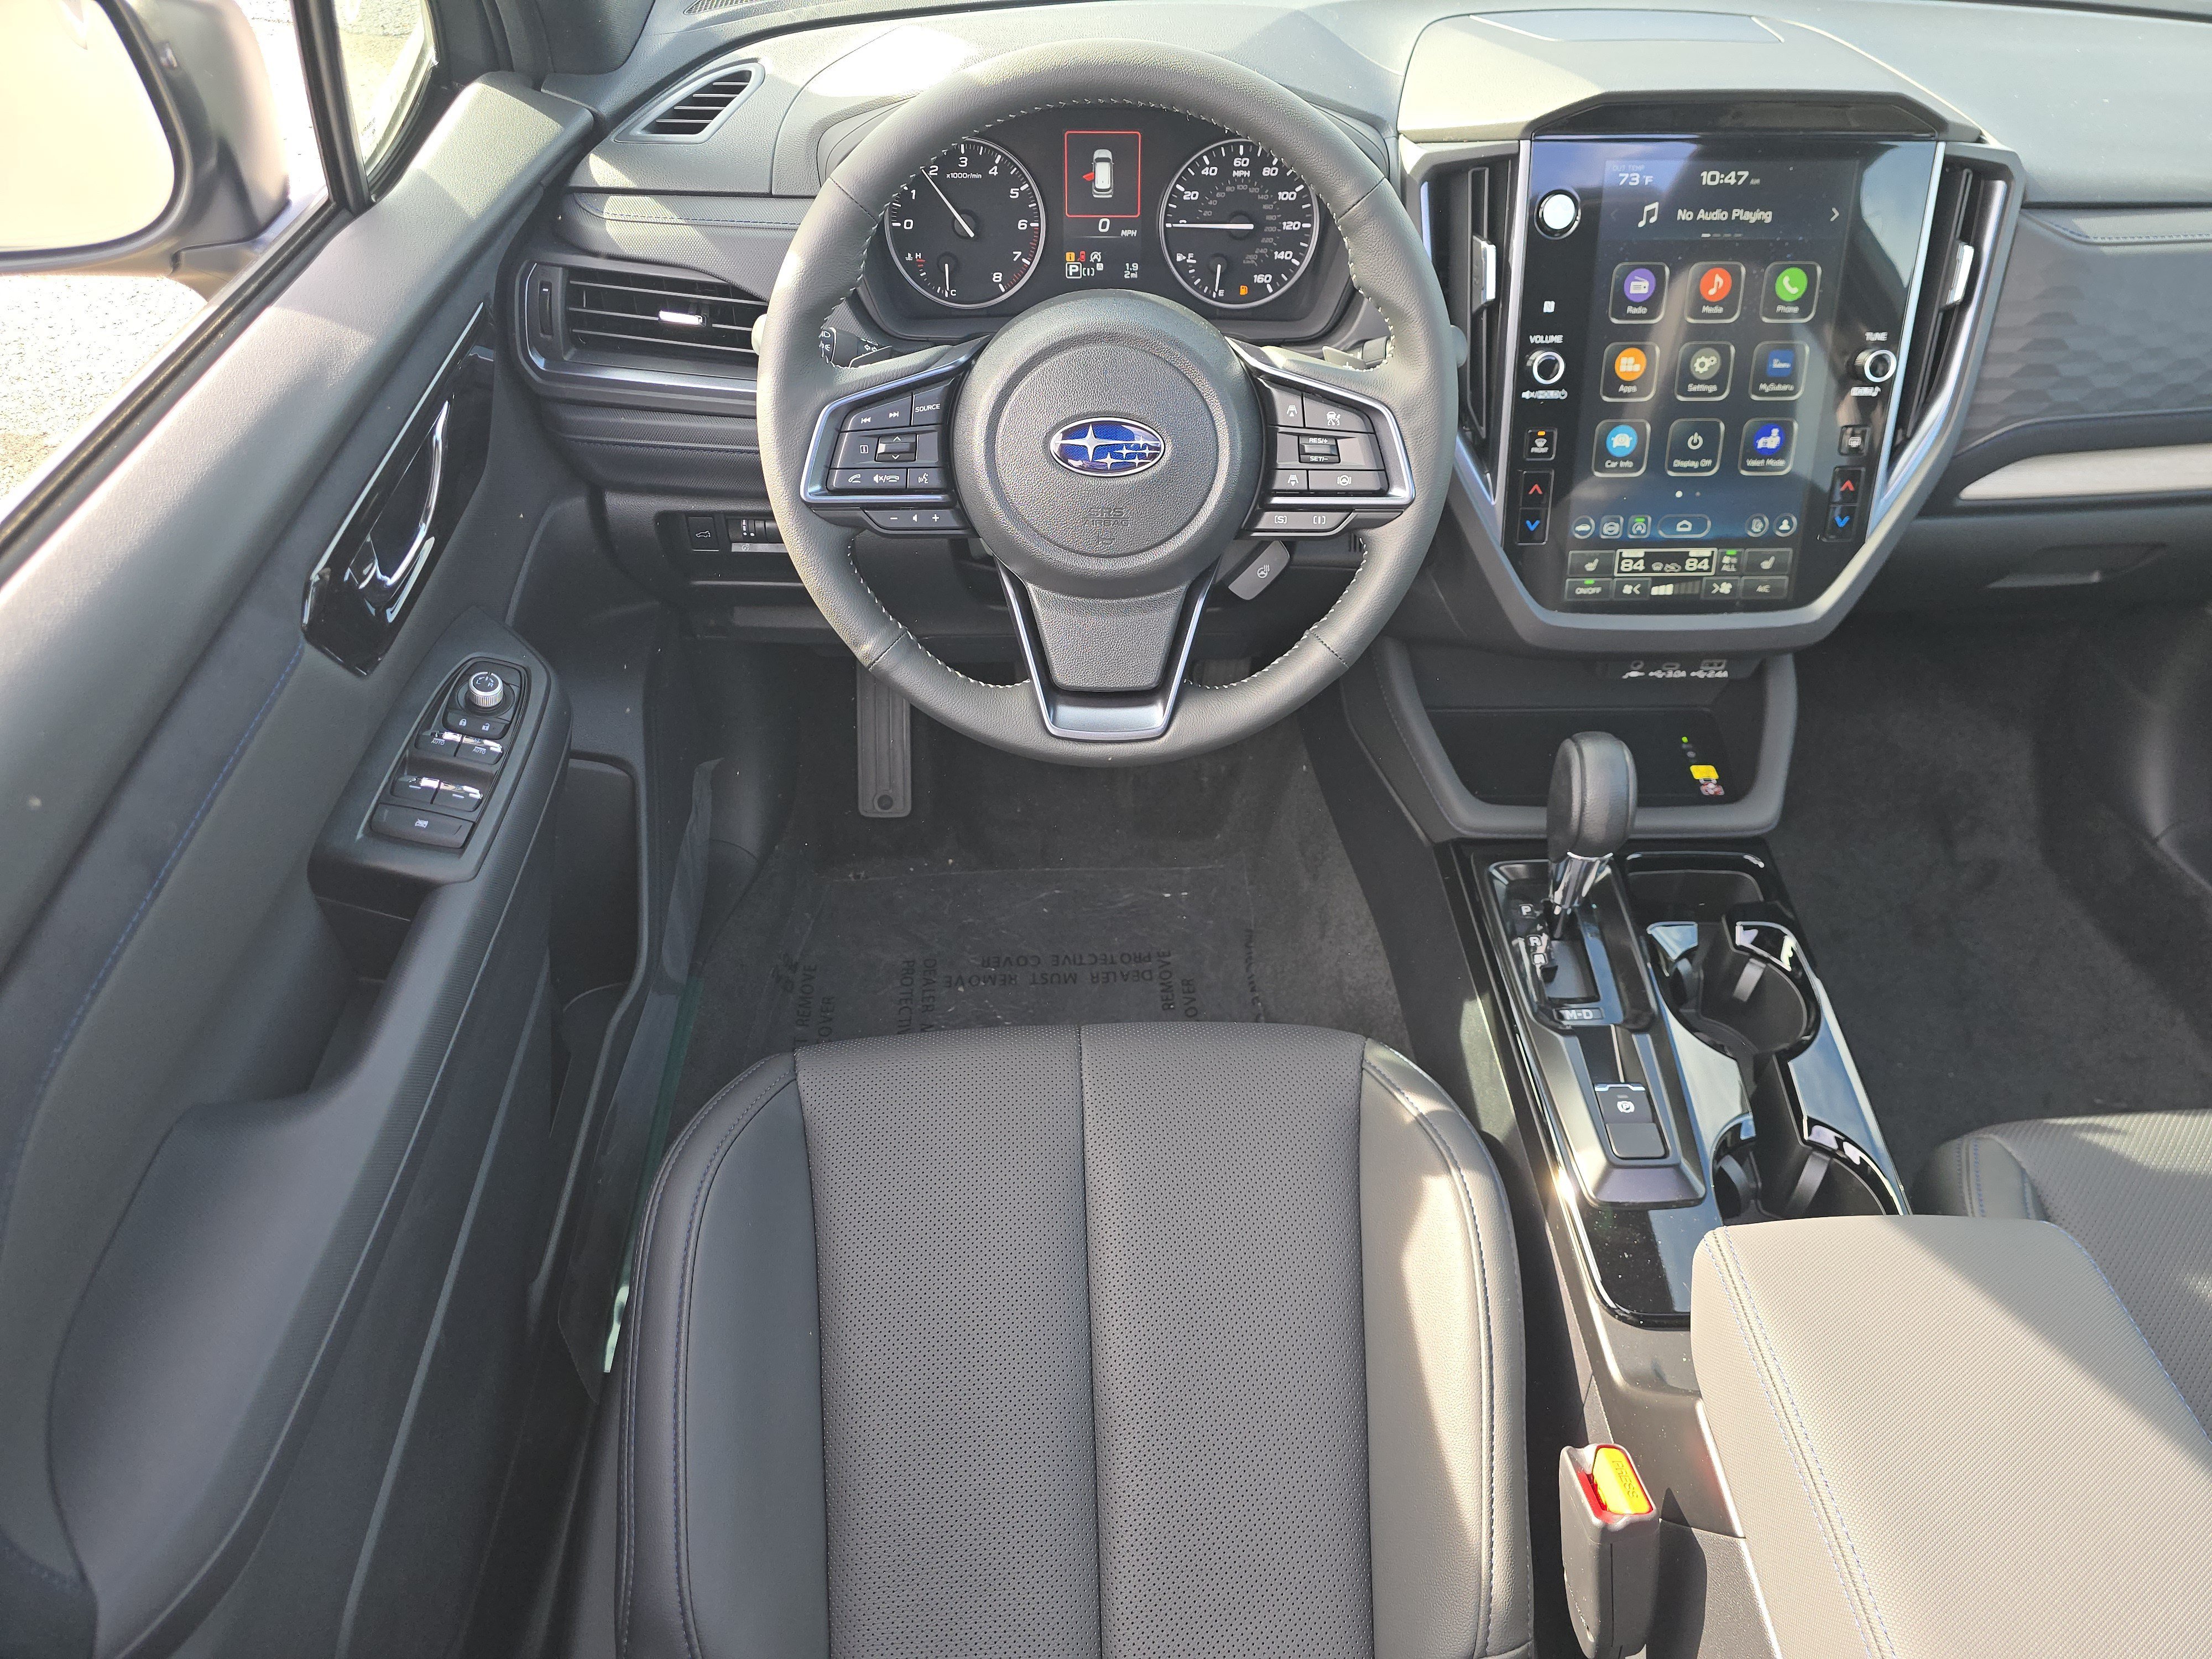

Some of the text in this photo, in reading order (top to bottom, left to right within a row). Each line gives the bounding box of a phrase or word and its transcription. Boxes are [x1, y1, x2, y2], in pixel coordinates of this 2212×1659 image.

[958, 157, 968, 167] 3
[1233, 158, 1249, 167] 60
[929, 165, 938, 176] 2
[988, 166, 998, 176] 4
[1201, 167, 1218, 176] 40
[1262, 167, 1279, 176] 80
[1618, 173, 1640, 186] 73
[1700, 170, 1749, 186] 10:47
[910, 189, 916, 200] 1
[1009, 189, 1020, 199] 5
[1183, 191, 1199, 200] 20
[1277, 191, 1297, 201] 100
[1677, 208, 1773, 223] No Audio Playing
[903, 219, 914, 230] 0
[1018, 220, 1028, 230] 6
[1098, 218, 1110, 232] 0
[1282, 221, 1301, 231] 120
[1013, 251, 1022, 262] 7
[1274, 251, 1293, 260] 140
[1069, 264, 1079, 276] P
[1125, 263, 1139, 271] 1.9
[992, 272, 1003, 283] 8
[1253, 274, 1272, 283] 160
[1776, 305, 1799, 314] Phone
[1529, 335, 1563, 344] VOLUME
[1865, 332, 1888, 341] TUNE
[1619, 384, 1637, 393] Apps
[915, 403, 941, 413] SOURCE
[1620, 559, 1645, 572] 84
[1684, 558, 1710, 571] 84
[1521, 905, 1532, 916] P
[980, 952, 1152, 968] PROTECTIVE COVER
[942, 969, 1153, 988] DEALER MUST REMOVE
[921, 958, 937, 1013] DEALER
[1181, 978, 1198, 1020] OVER
[1612, 1460, 1638, 1499] PRESS
